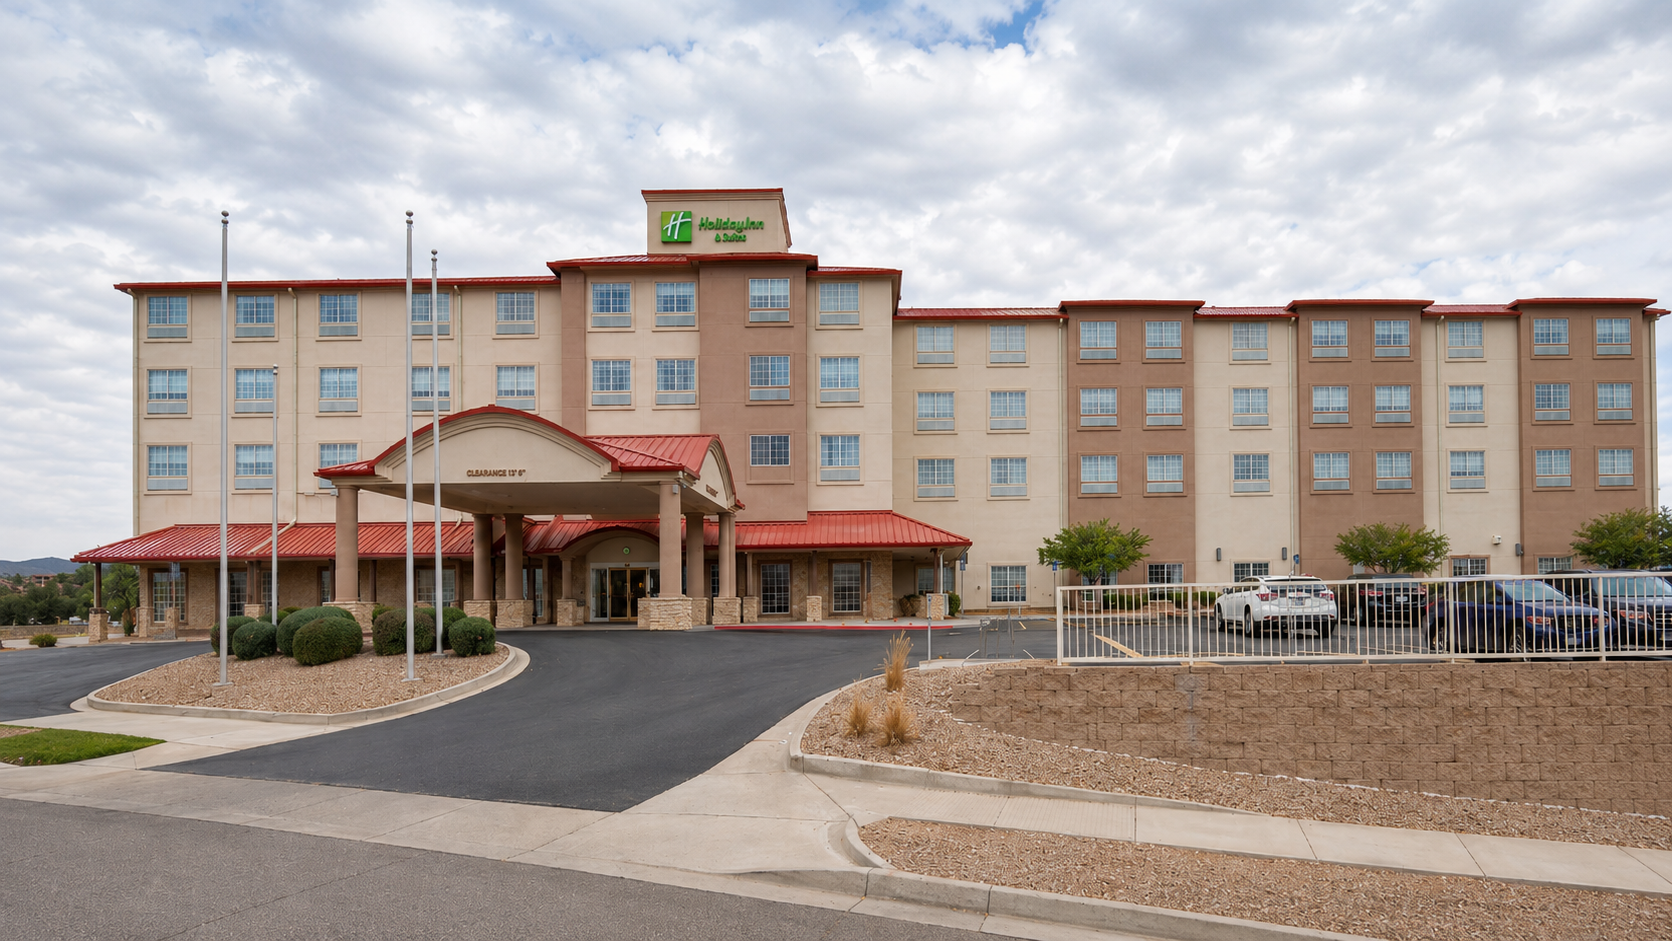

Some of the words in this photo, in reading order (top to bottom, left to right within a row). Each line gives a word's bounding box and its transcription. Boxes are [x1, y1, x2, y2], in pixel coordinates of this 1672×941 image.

[698, 217, 744, 233] Holiday
[722, 233, 746, 242] Suites
[466, 469, 507, 477] CLEARANCE
